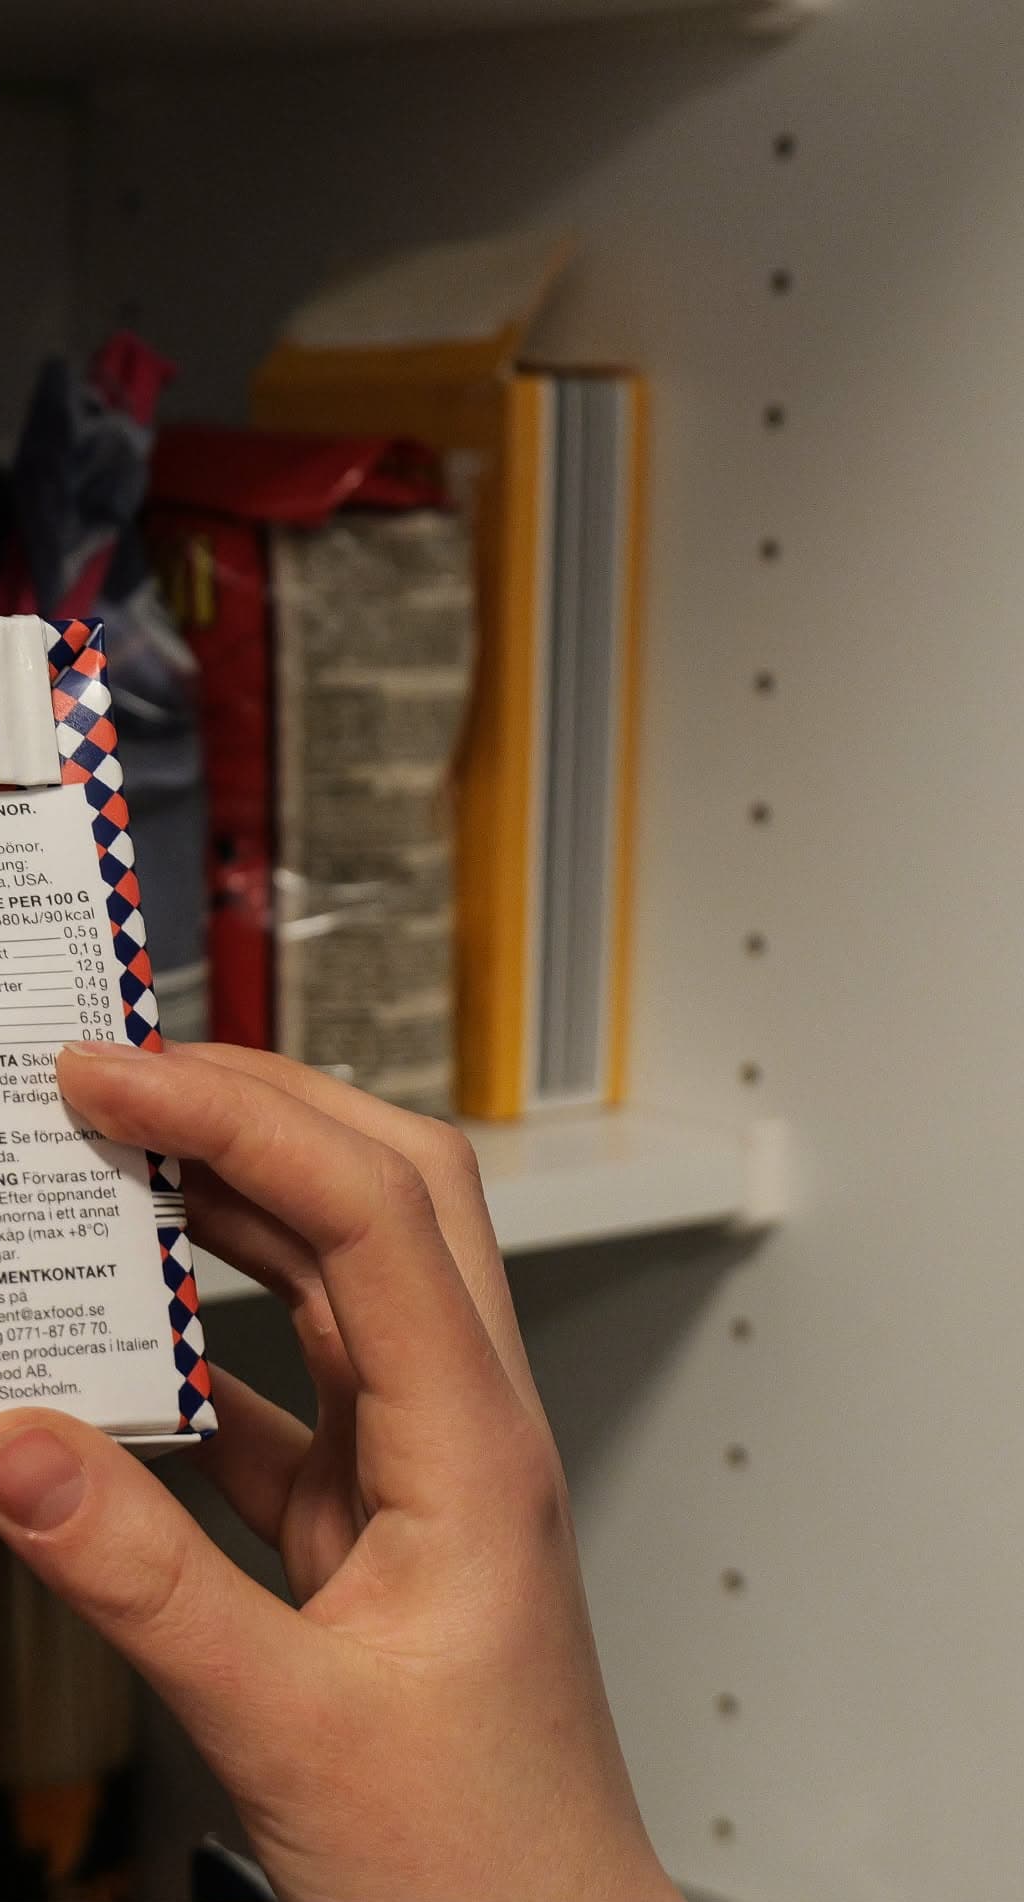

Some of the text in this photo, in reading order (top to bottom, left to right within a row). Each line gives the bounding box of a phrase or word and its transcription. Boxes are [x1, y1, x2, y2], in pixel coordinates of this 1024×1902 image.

[14, 873, 53, 886] USA.
[9, 894, 42, 908] PER
[45, 892, 73, 905] 100
[78, 891, 89, 902] G
[65, 908, 95, 921] kcal
[77, 960, 91, 970] 12
[22, 1053, 56, 1068] Skölj
[21, 1072, 56, 1084] vatte
[3, 1090, 58, 1104] Färdiga
[11, 1131, 30, 1144] Se
[35, 1128, 106, 1143] förpackn
[23, 1171, 87, 1184] Förvaras
[91, 1168, 122, 1181] torrt
[37, 1188, 117, 1203] öppnandet
[57, 1209, 76, 1220] ett
[80, 1206, 120, 1218] annat
[29, 1226, 64, 1241] (max
[69, 1223, 109, 1238] +8°C)
[10, 1290, 27, 1305] på
[7, 1323, 63, 1341] 0771-87
[70, 1323, 86, 1334] 67
[90, 1321, 111, 1333] 70.
[25, 1341, 106, 1360] produceras
[117, 1338, 158, 1352] Italien
[0, 1381, 82, 1399] Stockholm.
